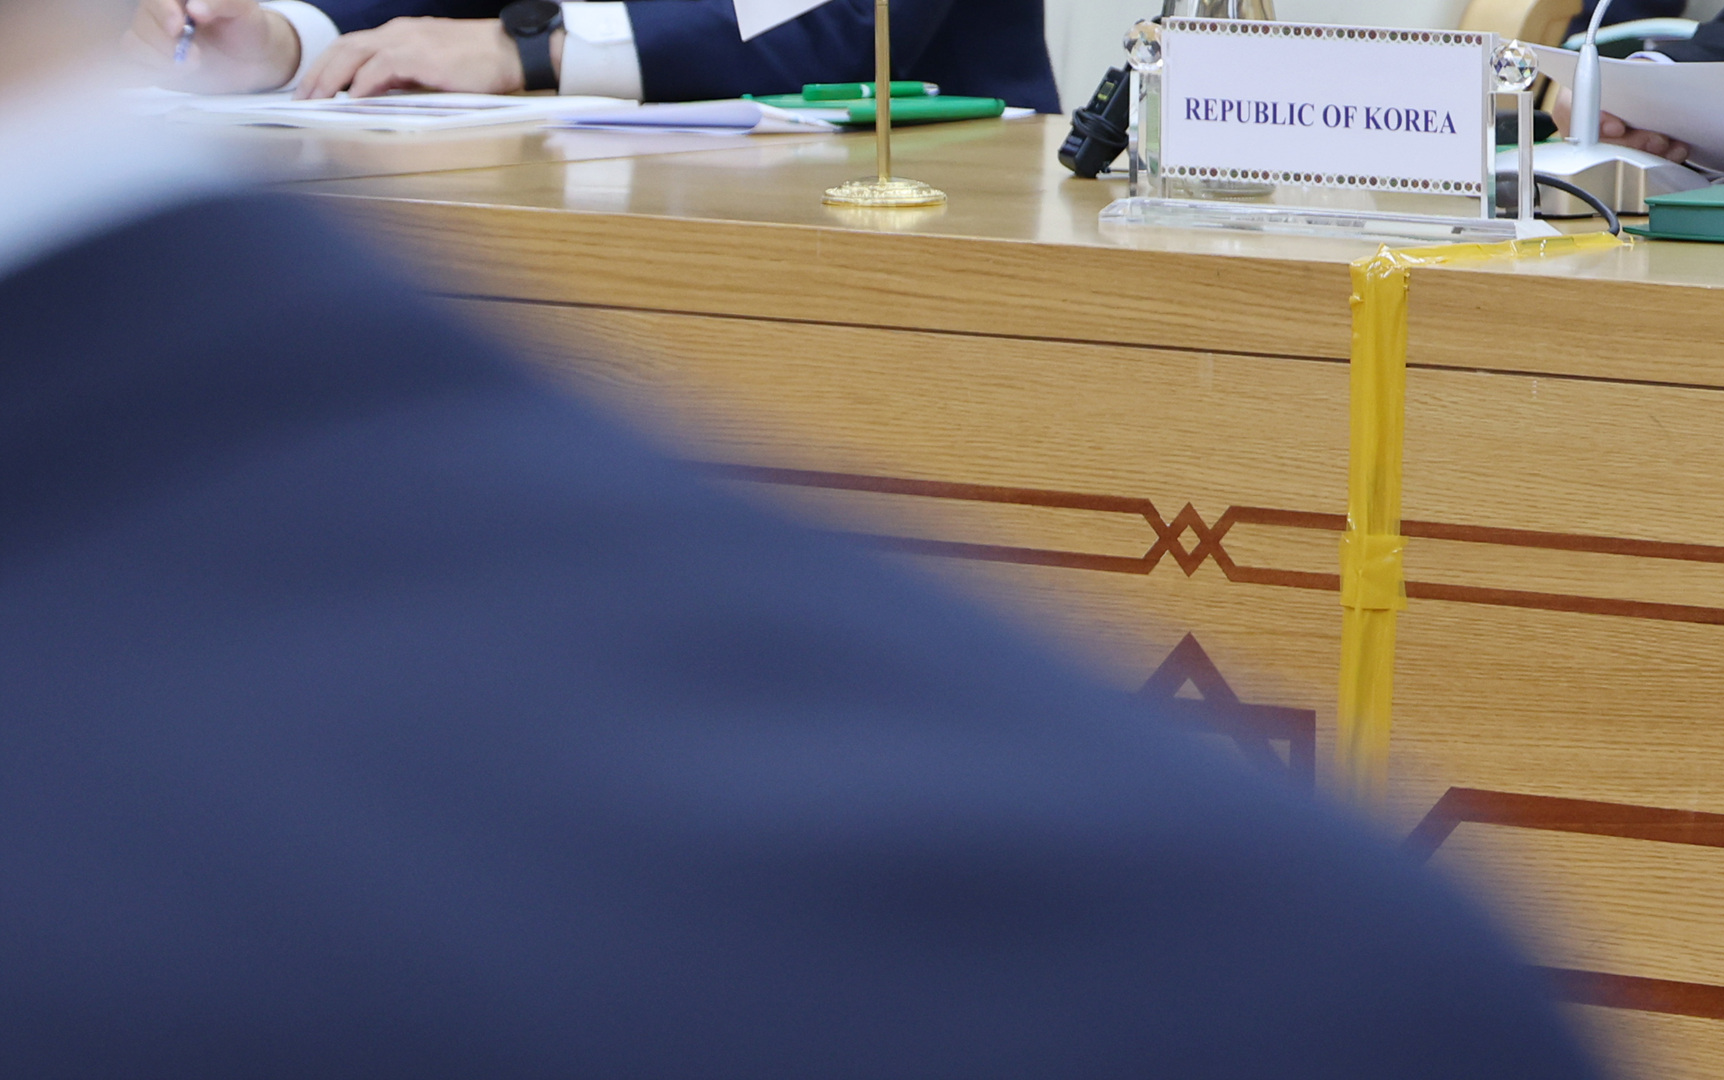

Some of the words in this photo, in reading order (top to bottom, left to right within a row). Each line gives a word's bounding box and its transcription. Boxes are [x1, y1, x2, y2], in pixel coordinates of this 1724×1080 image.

[1184, 96, 1315, 128] REPUBLIC
[1321, 104, 1358, 130] OF
[1364, 106, 1458, 135] KOREA
